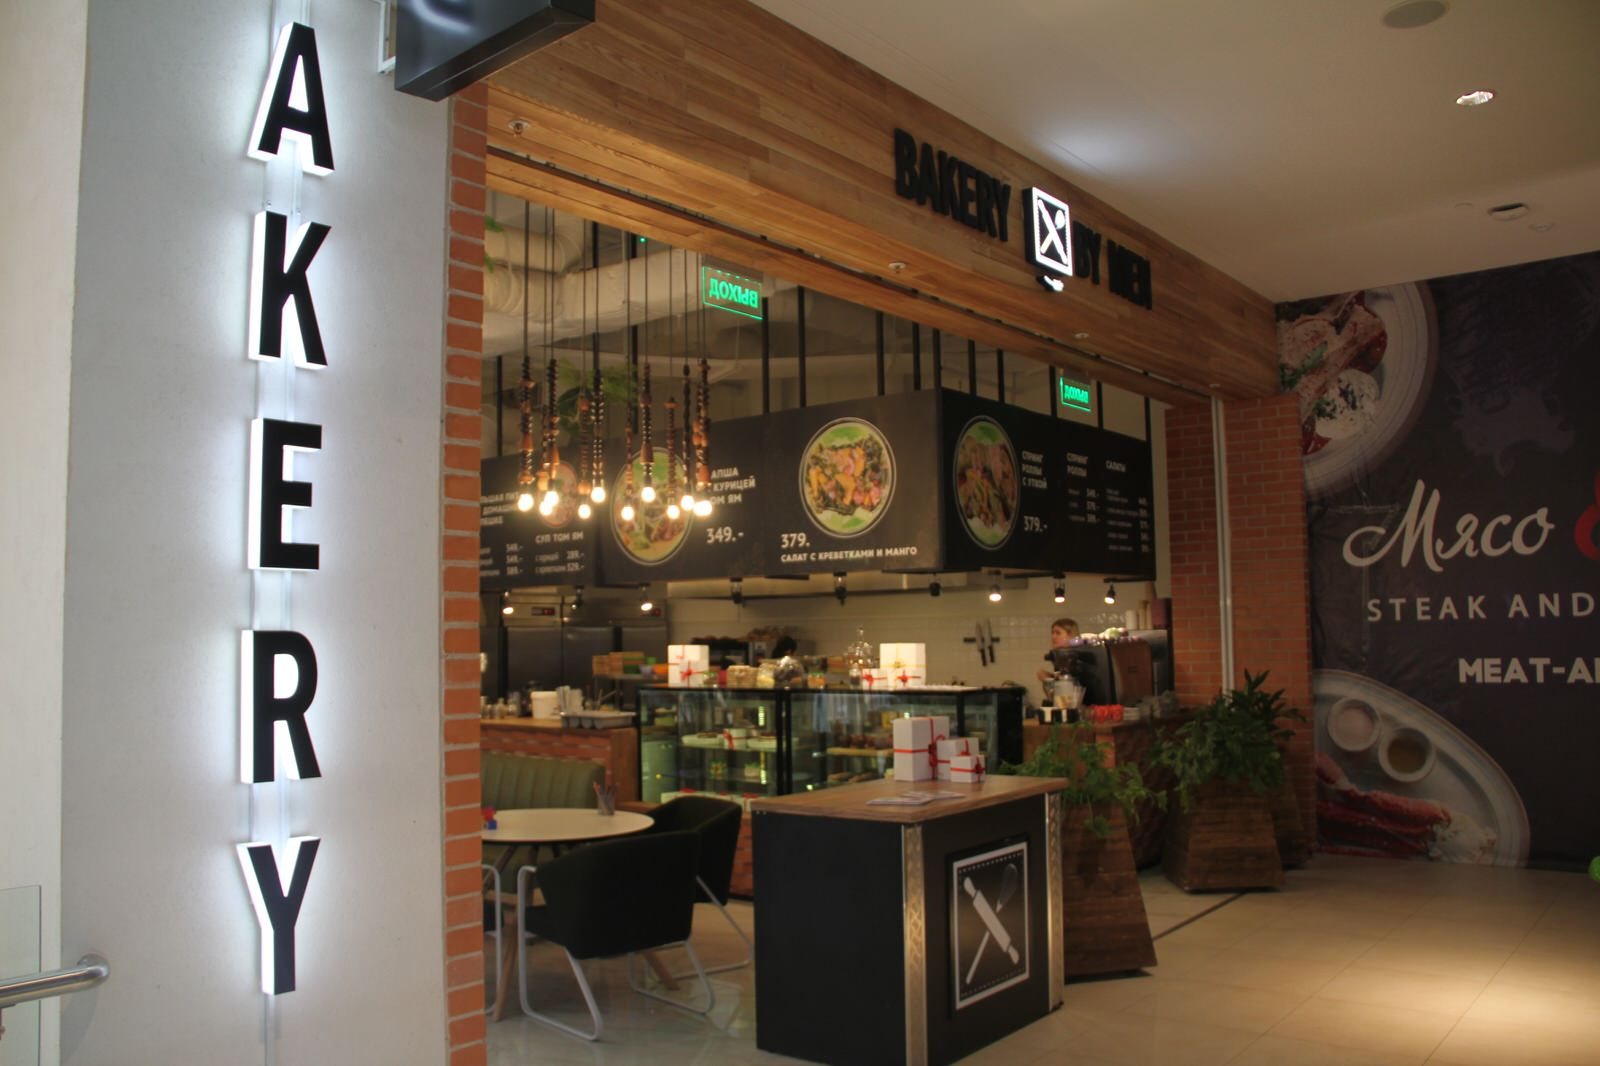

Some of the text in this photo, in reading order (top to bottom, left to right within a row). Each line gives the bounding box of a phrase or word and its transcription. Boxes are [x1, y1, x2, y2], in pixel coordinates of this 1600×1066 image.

[894, 127, 1011, 242] BAKERY
[710, 467, 739, 479] АПША
[713, 475, 756, 492] КУРИЦЕЙ
[1342, 479, 1555, 572] Мясо
[707, 526, 744, 544] 349.-
[780, 532, 811, 548] 379.
[781, 546, 917, 563] САЛАТ С КРЕВЕТКАМИ И МАНГО
[1367, 592, 1595, 622] STEAK AND
[1458, 657, 1600, 684] MEAT-A
